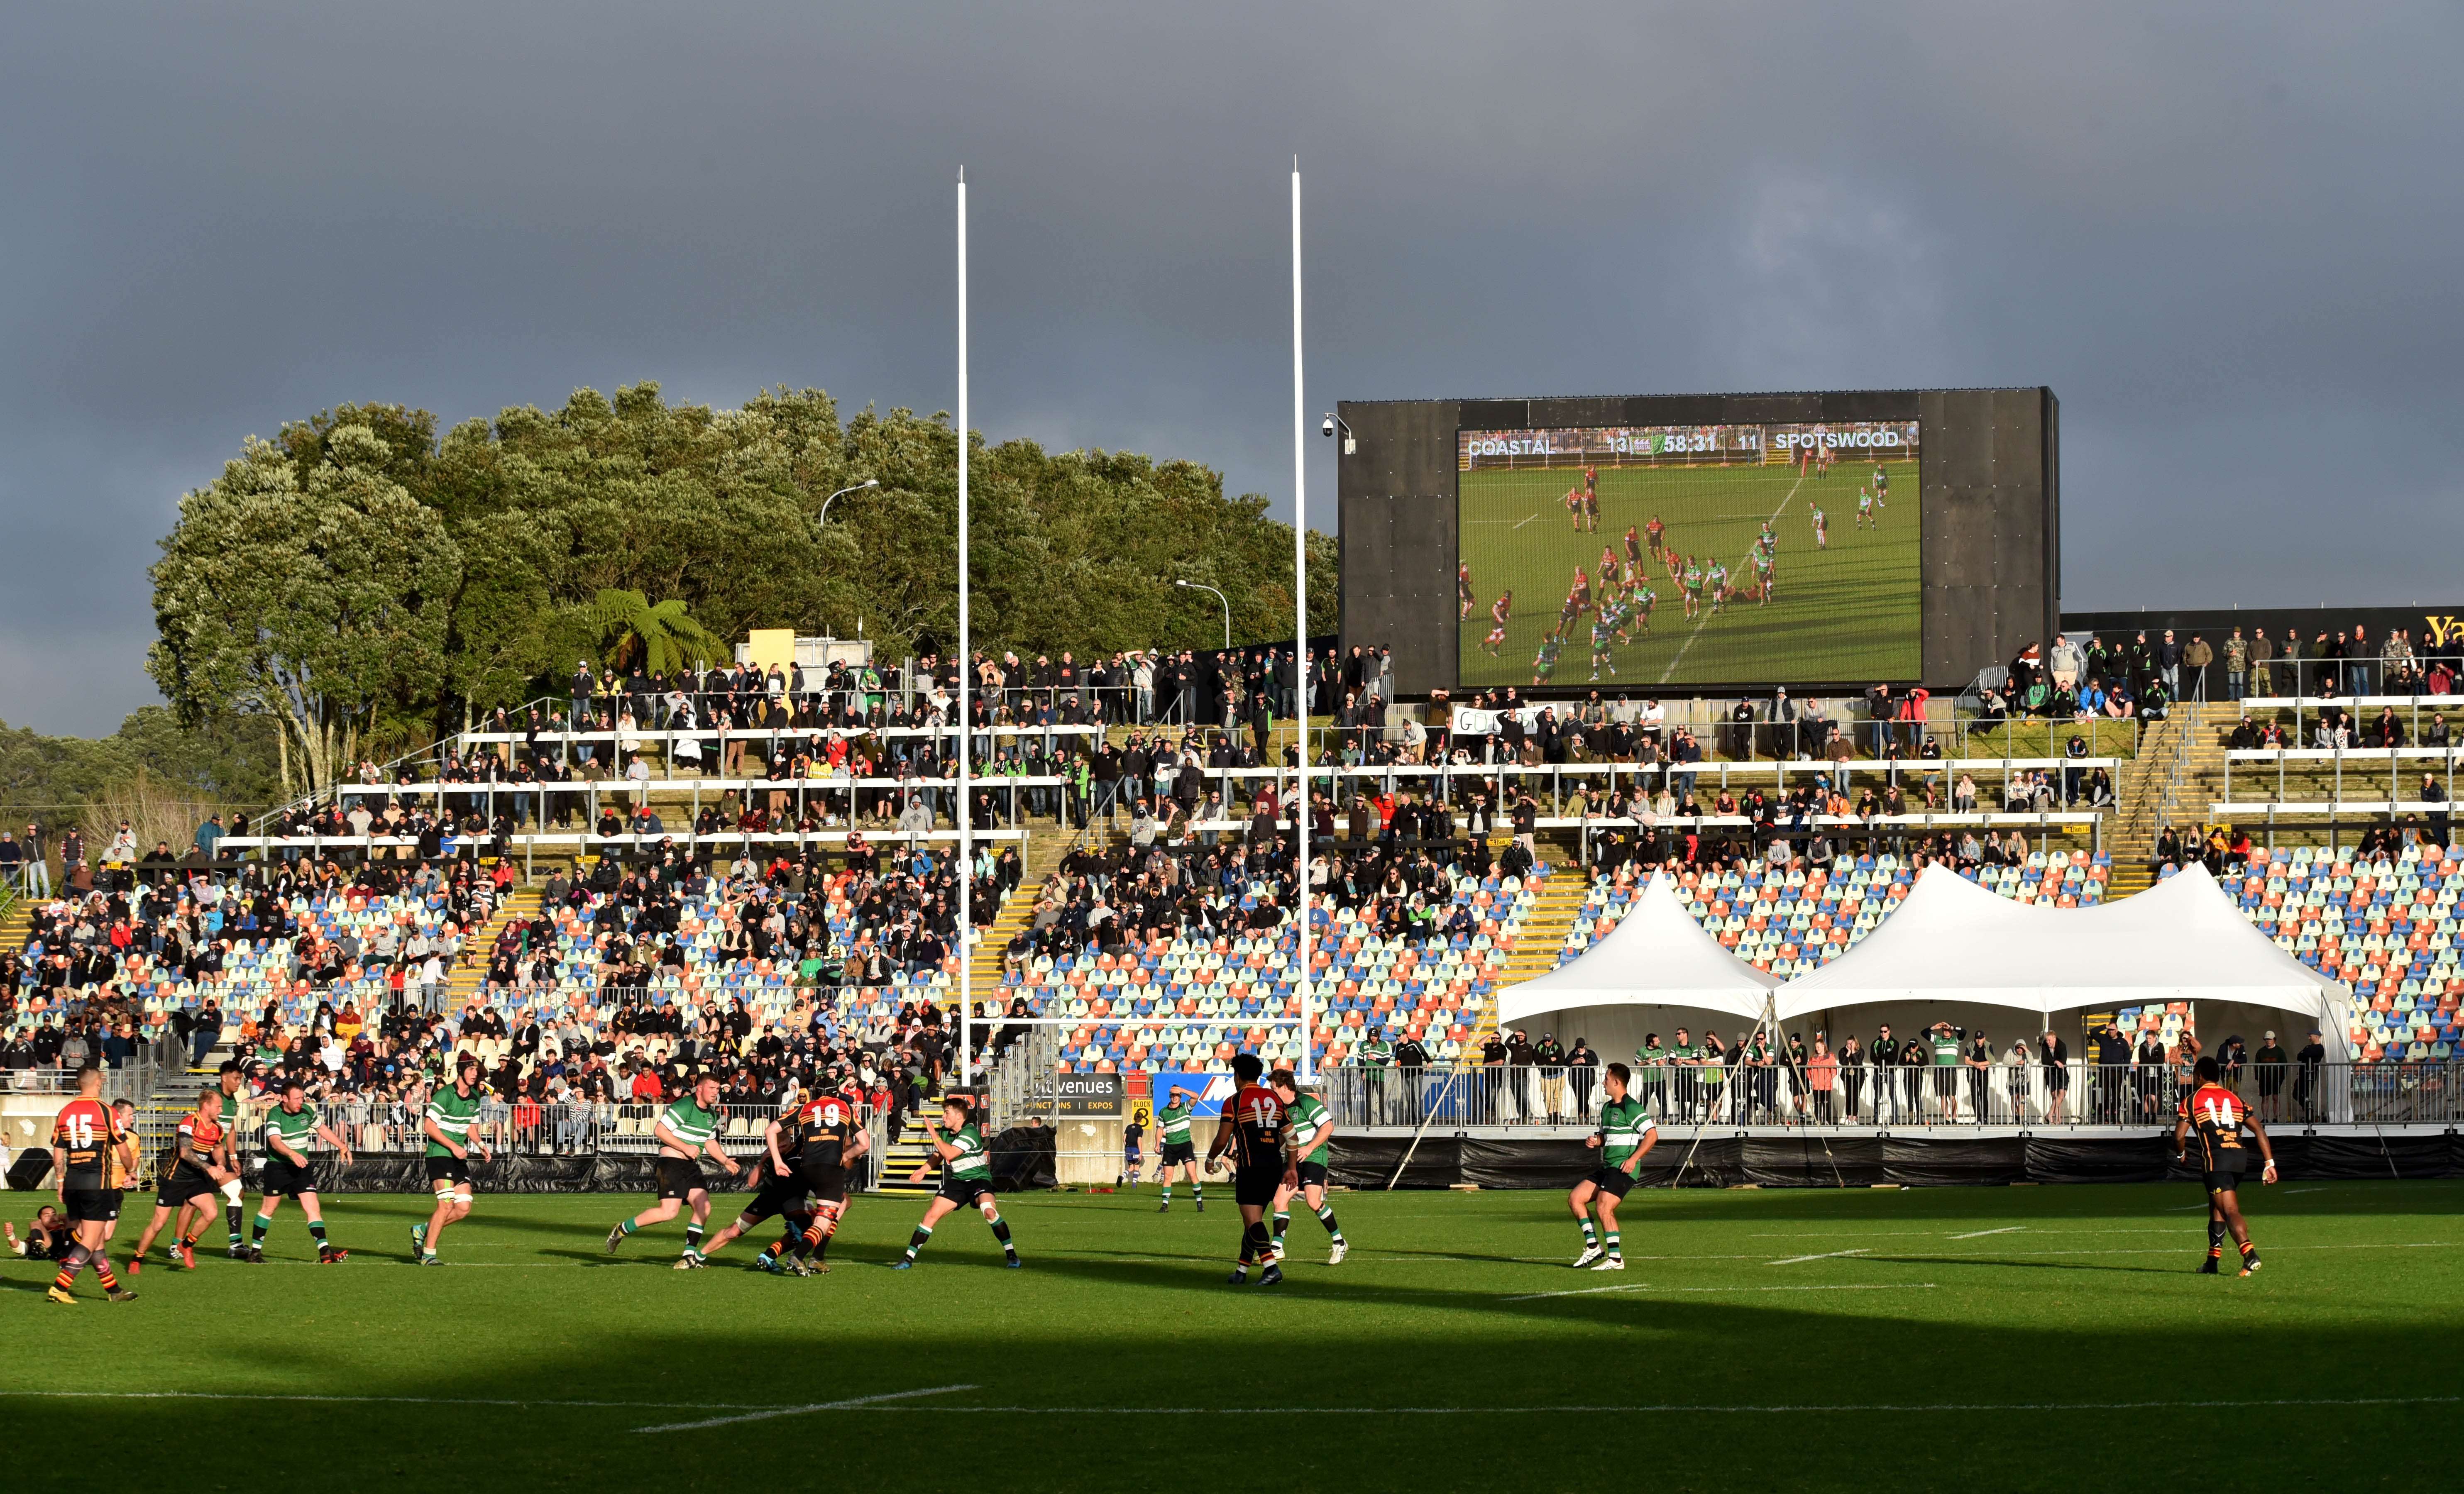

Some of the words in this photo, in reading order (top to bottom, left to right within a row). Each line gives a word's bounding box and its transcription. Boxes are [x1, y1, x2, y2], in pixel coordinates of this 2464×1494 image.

[1468, 439, 1556, 456] COASTAL
[1607, 437, 1627, 452] 13
[1664, 435, 1715, 452] 58:31
[1738, 435, 1756, 450] 11
[1775, 431, 1899, 449] SPOTSWOOD
[1058, 1081, 1113, 1093] venues
[812, 1104, 839, 1128] 19
[1251, 1097, 1277, 1128] 12
[2205, 1097, 2235, 1129] 14
[66, 1114, 93, 1149] 15
